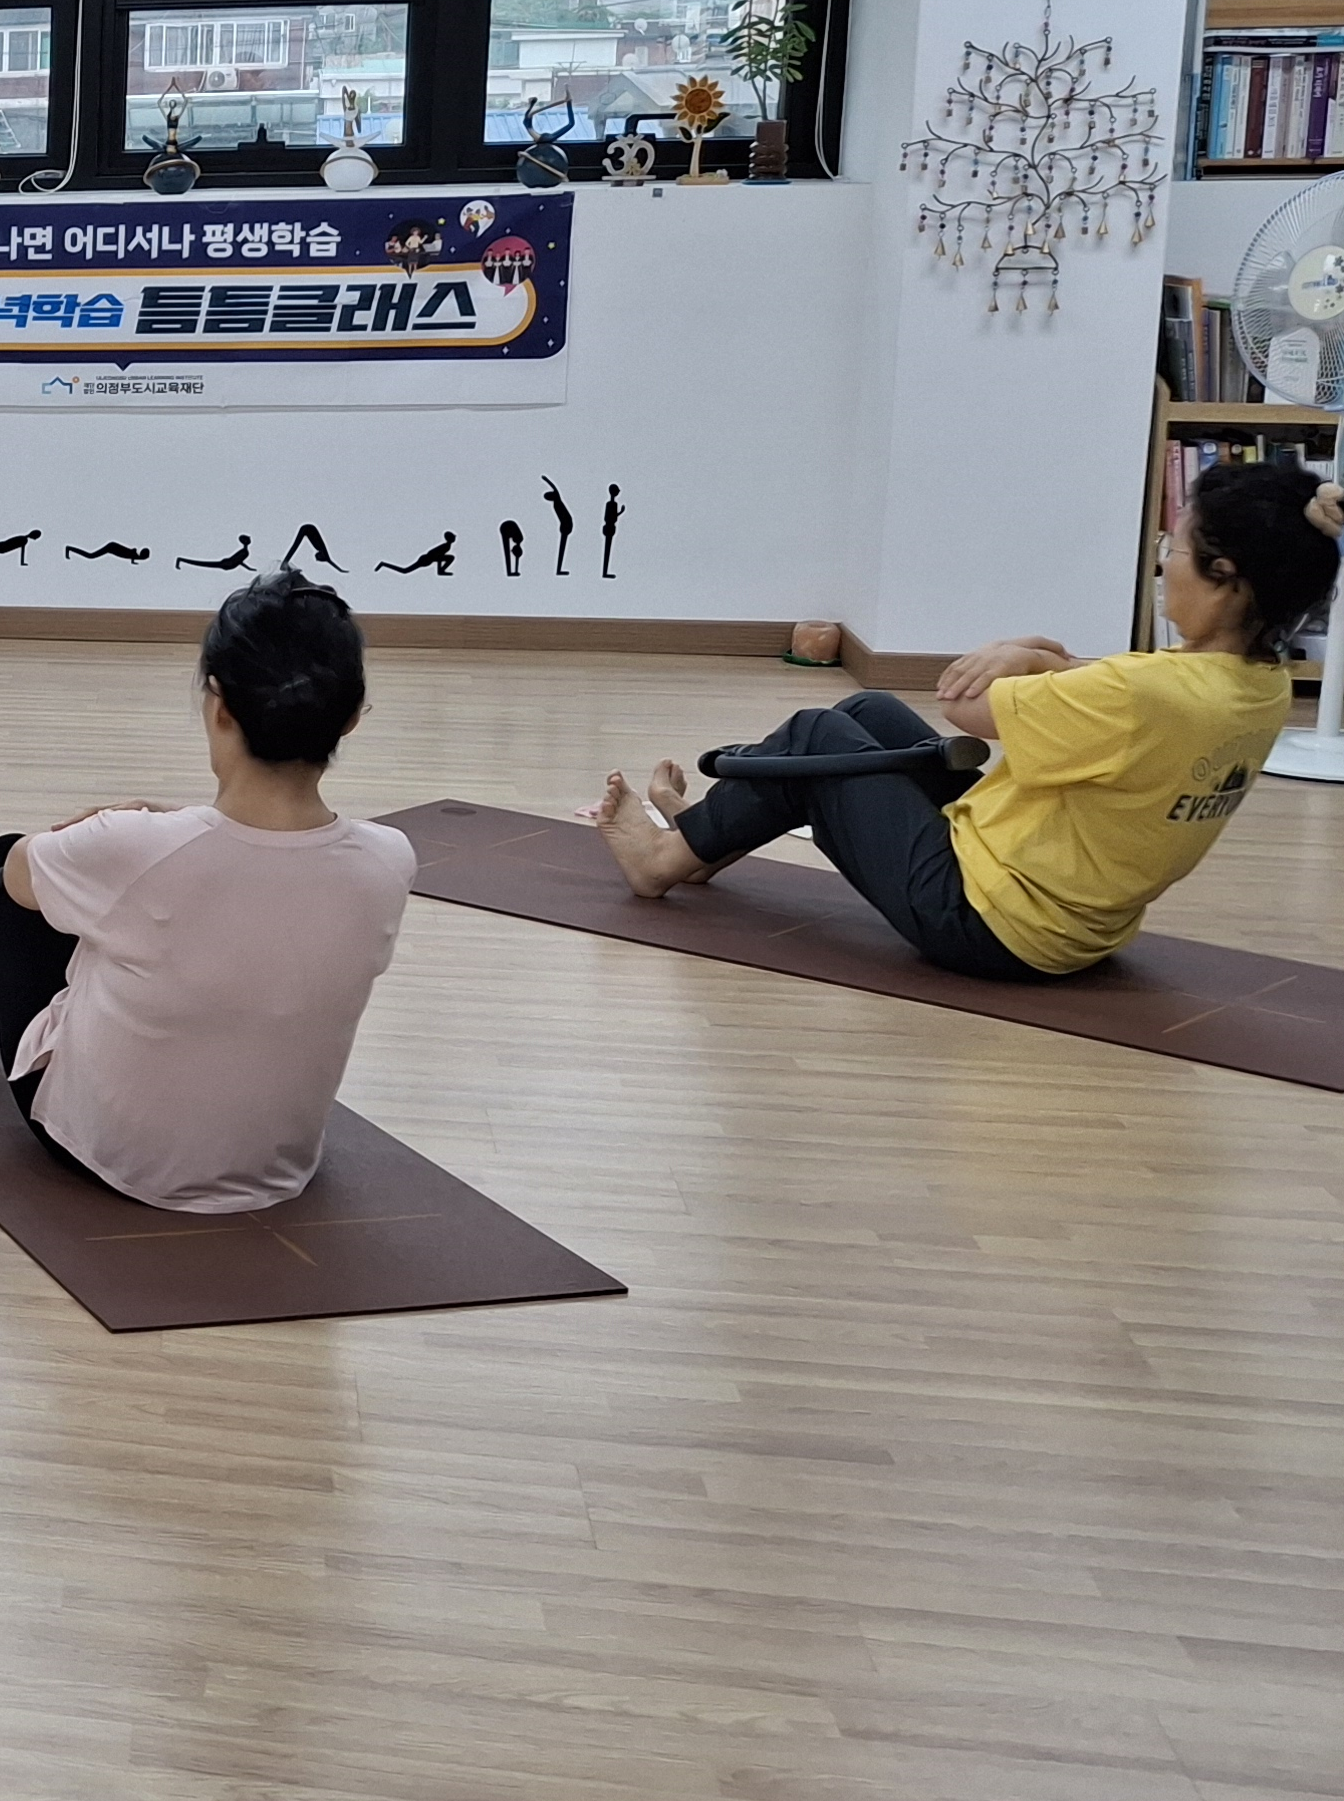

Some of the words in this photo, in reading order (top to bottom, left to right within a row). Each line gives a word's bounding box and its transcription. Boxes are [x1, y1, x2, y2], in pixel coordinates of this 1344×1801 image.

[63, 223, 196, 260] 어디서나
[201, 221, 343, 259] 평생학습
[134, 280, 478, 335] 틈틈클래스
[95, 381, 205, 395] 의정부도시교육재단
